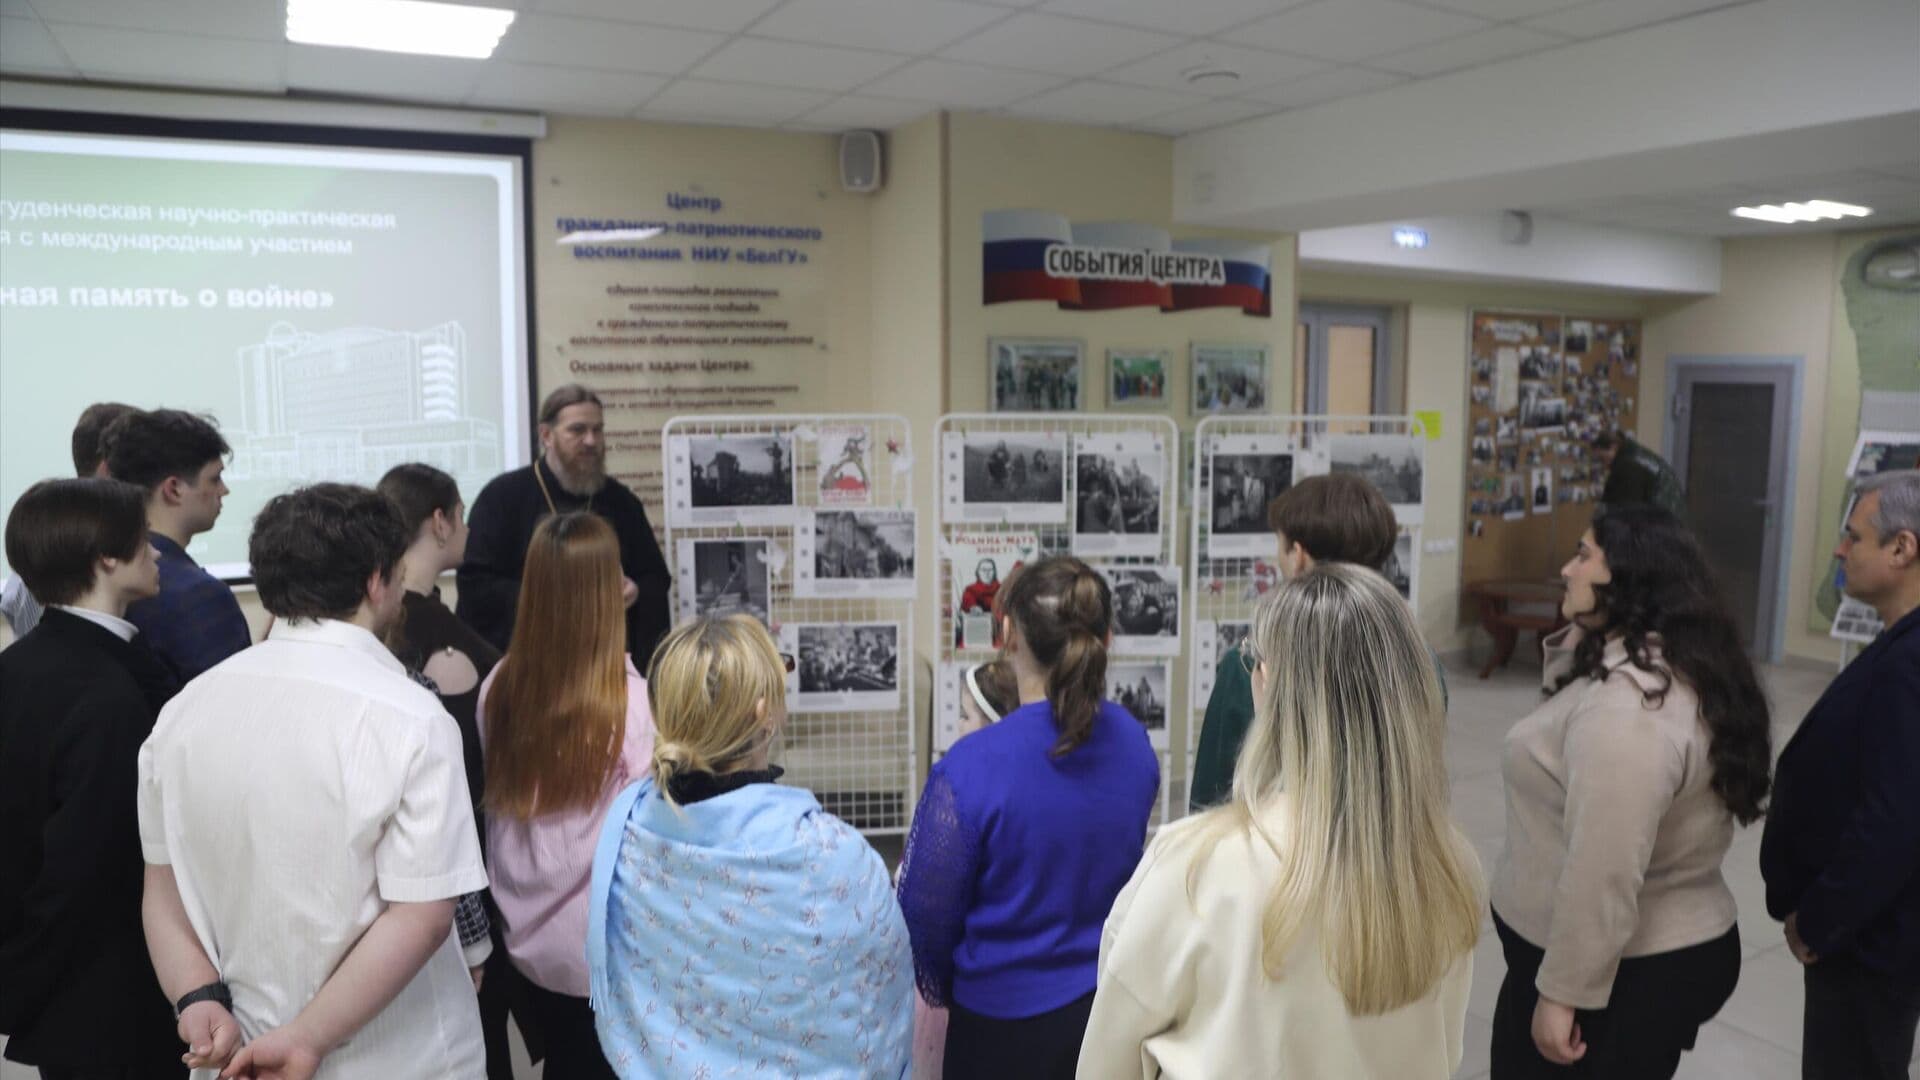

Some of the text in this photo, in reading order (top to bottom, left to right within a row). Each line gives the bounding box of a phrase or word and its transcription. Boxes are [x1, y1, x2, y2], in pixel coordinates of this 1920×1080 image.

[667, 192, 722, 212] Центр
[160, 206, 396, 229] научно-практическая
[20, 231, 33, 246] с
[42, 232, 243, 253] международным
[250, 238, 353, 256] участием
[574, 246, 808, 264] воспитания НИУ «БелГУ»
[1049, 249, 1222, 280] СОБЫТИЯ ЦЕНТРА
[70, 288, 189, 307] память
[198, 290, 218, 307] о
[227, 284, 334, 308] войне»
